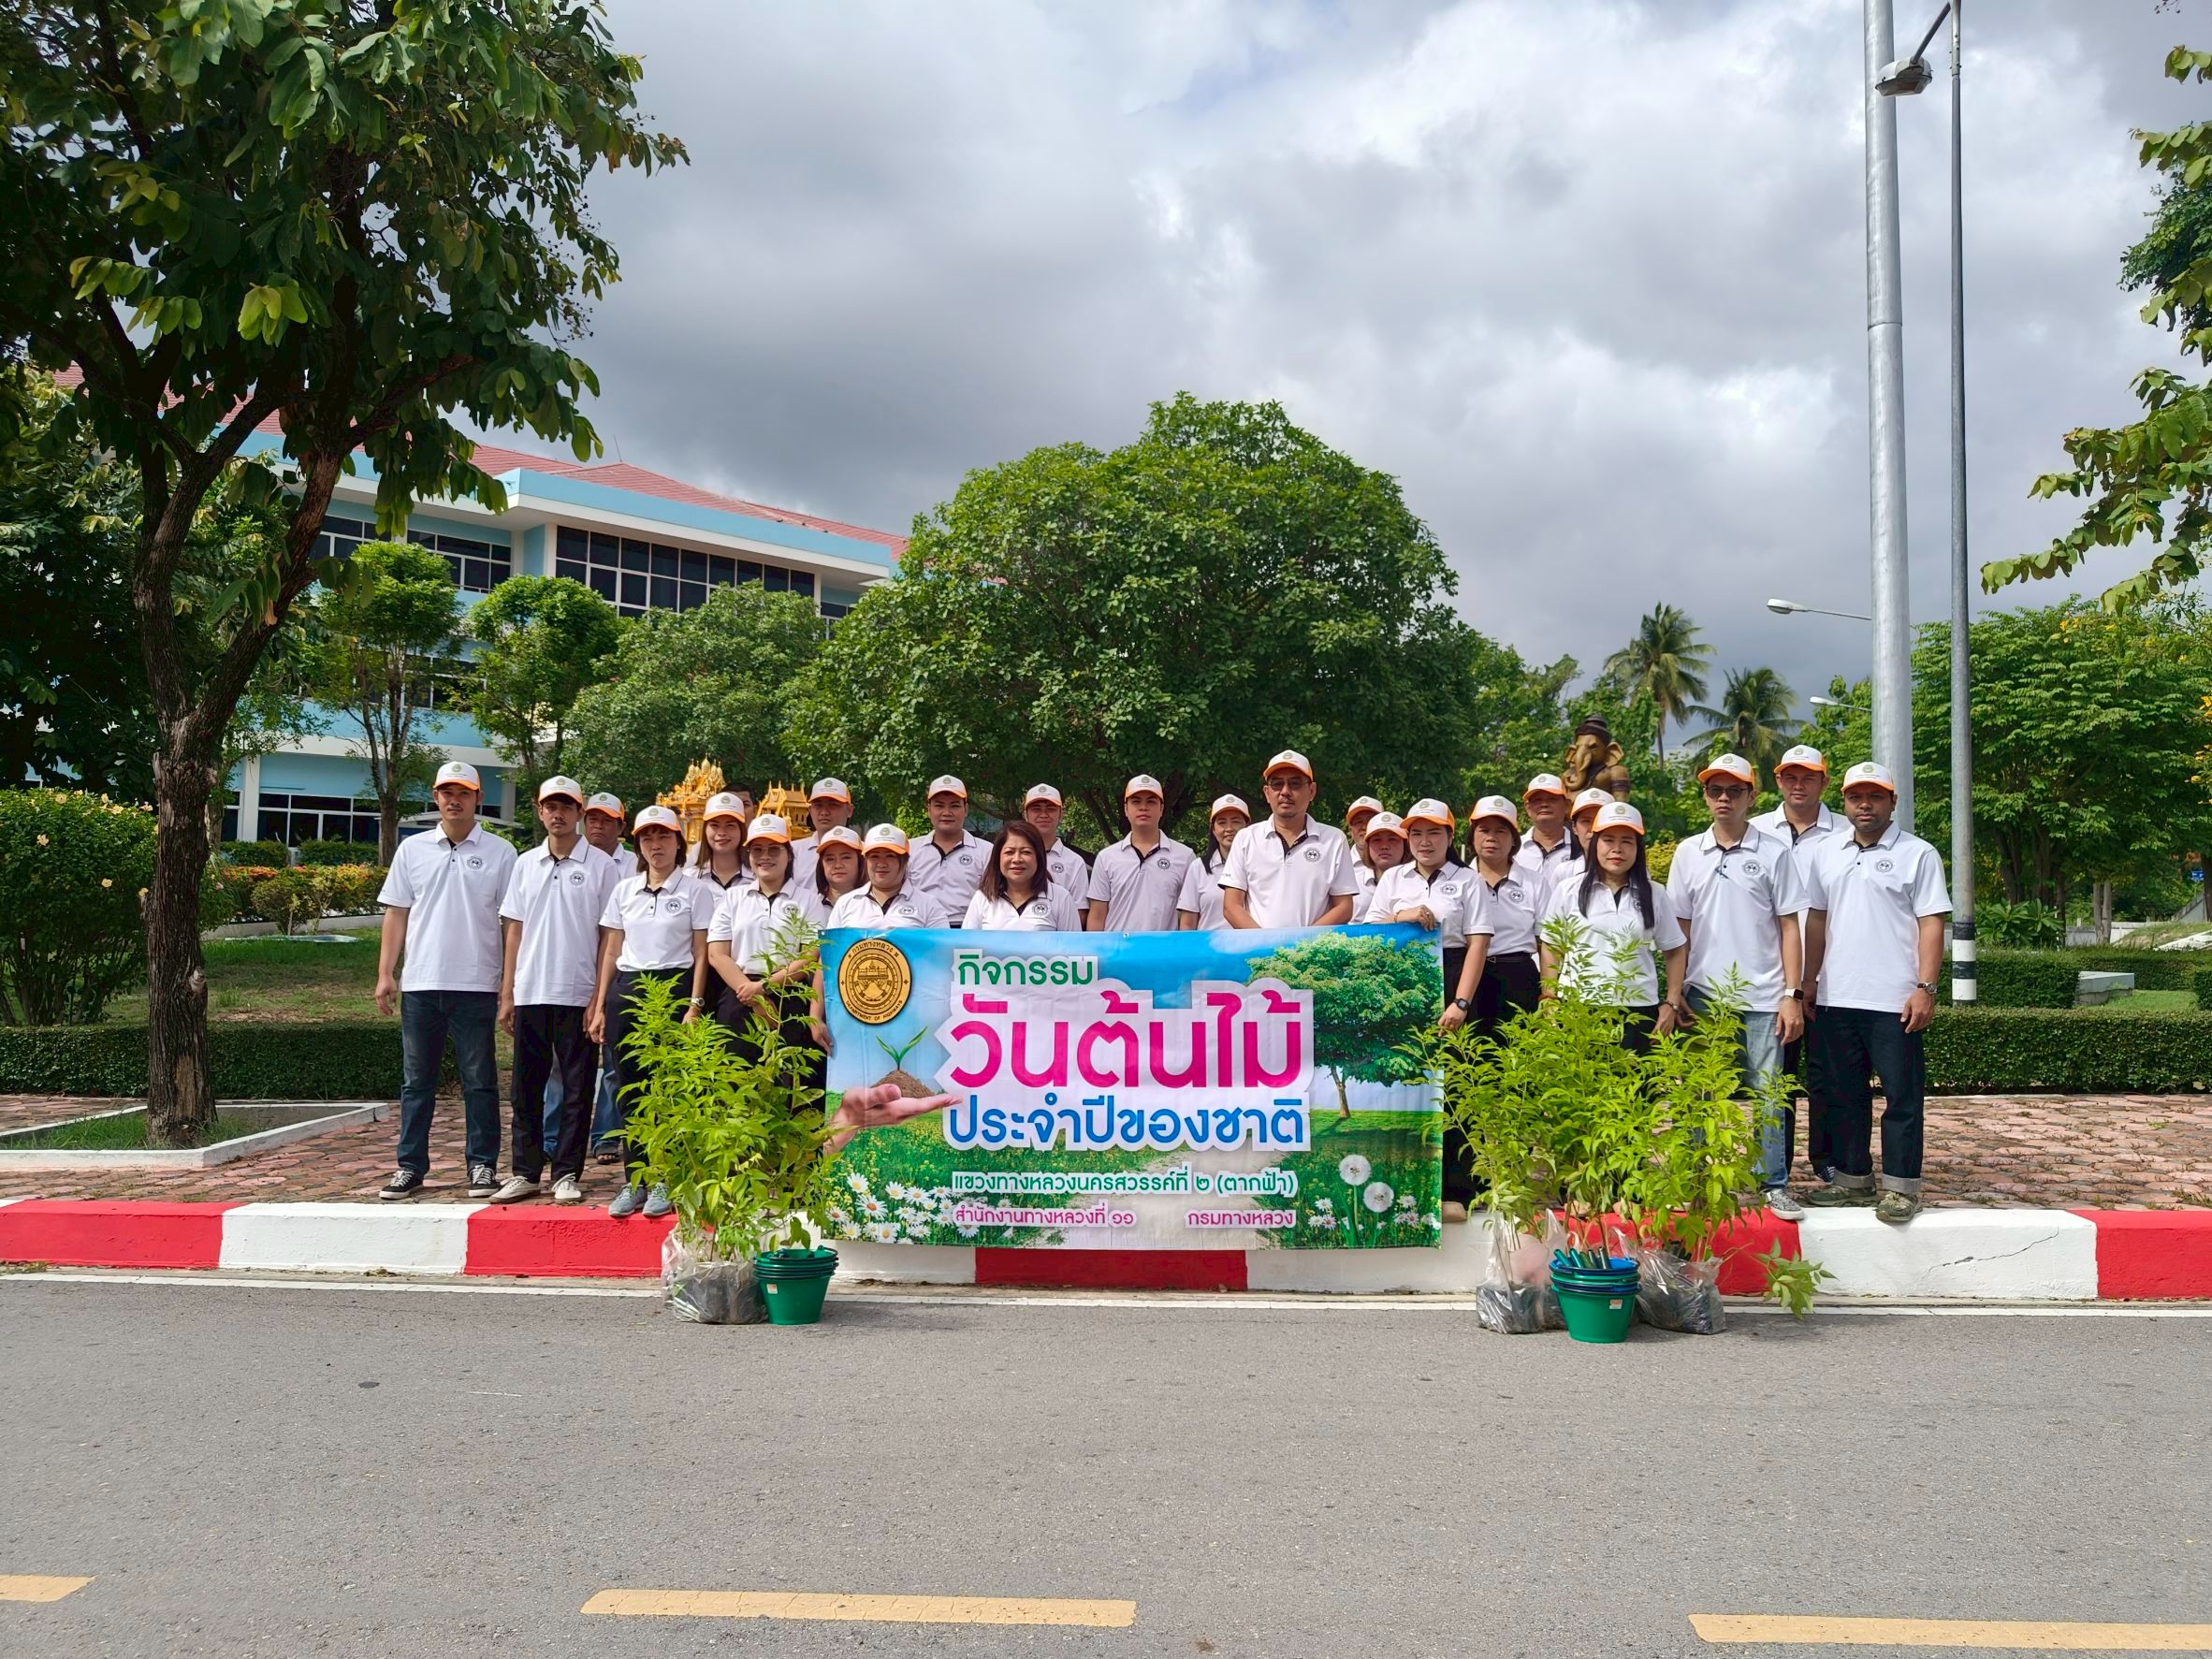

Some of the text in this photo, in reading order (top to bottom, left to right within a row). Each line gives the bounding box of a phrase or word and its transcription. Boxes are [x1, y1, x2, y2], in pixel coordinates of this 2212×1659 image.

[851, 941, 894, 953] กรมทางหลวง
[958, 953, 1093, 985] กิจกรรม
[846, 1000, 872, 1021] DEPARTMENT
[882, 999, 903, 1019] HIGHWAYS
[950, 990, 1302, 1088] วันต้นไม้
[950, 1092, 1303, 1143] ประจำปีของชาติ
[954, 1166, 1294, 1194] แขวงทางหลวงนครสวรรค์ที่ ๒ (ตากฟ้า)
[955, 1202, 1134, 1225] สำนักงานทางหลวงที่ ๑๑
[1187, 1213, 1294, 1226] กรมทางหลวง
